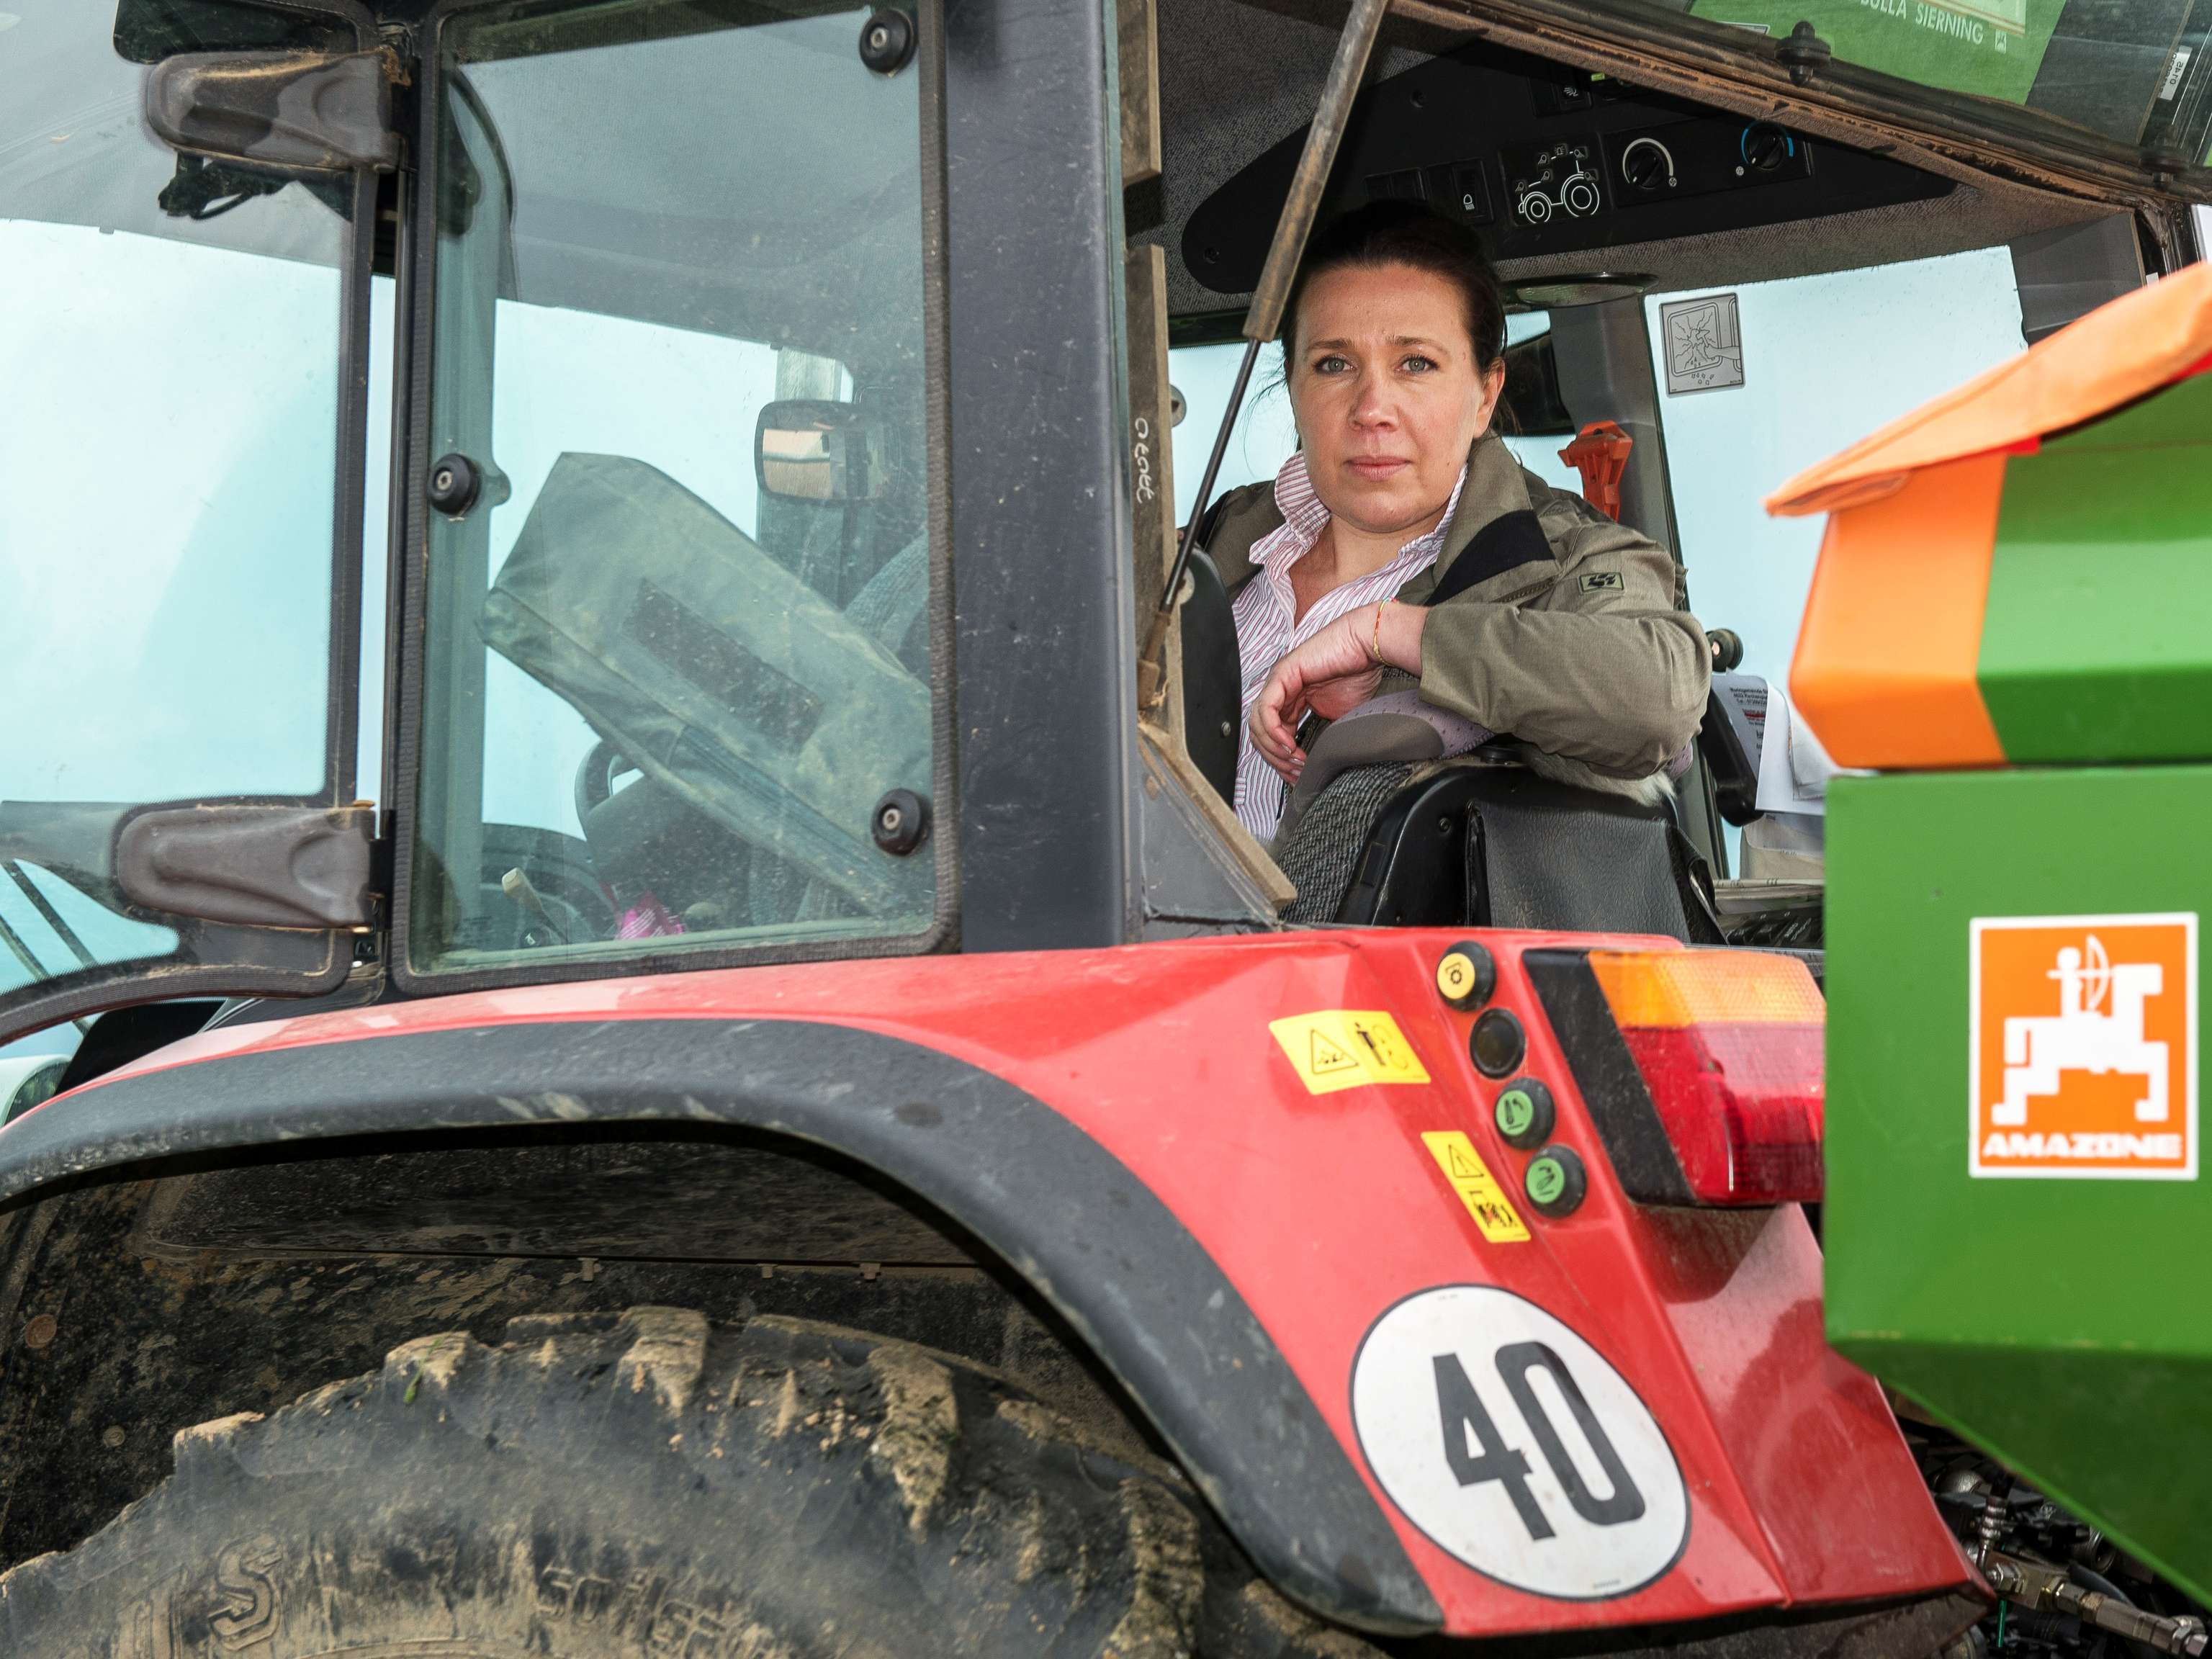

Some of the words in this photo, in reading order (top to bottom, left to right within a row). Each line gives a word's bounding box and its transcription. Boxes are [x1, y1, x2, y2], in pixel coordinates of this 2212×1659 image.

[1915, 2, 1984, 45] SIERNING
[1982, 1132, 2183, 1160] AMAZONE
[1432, 1340, 1646, 1542] 40
